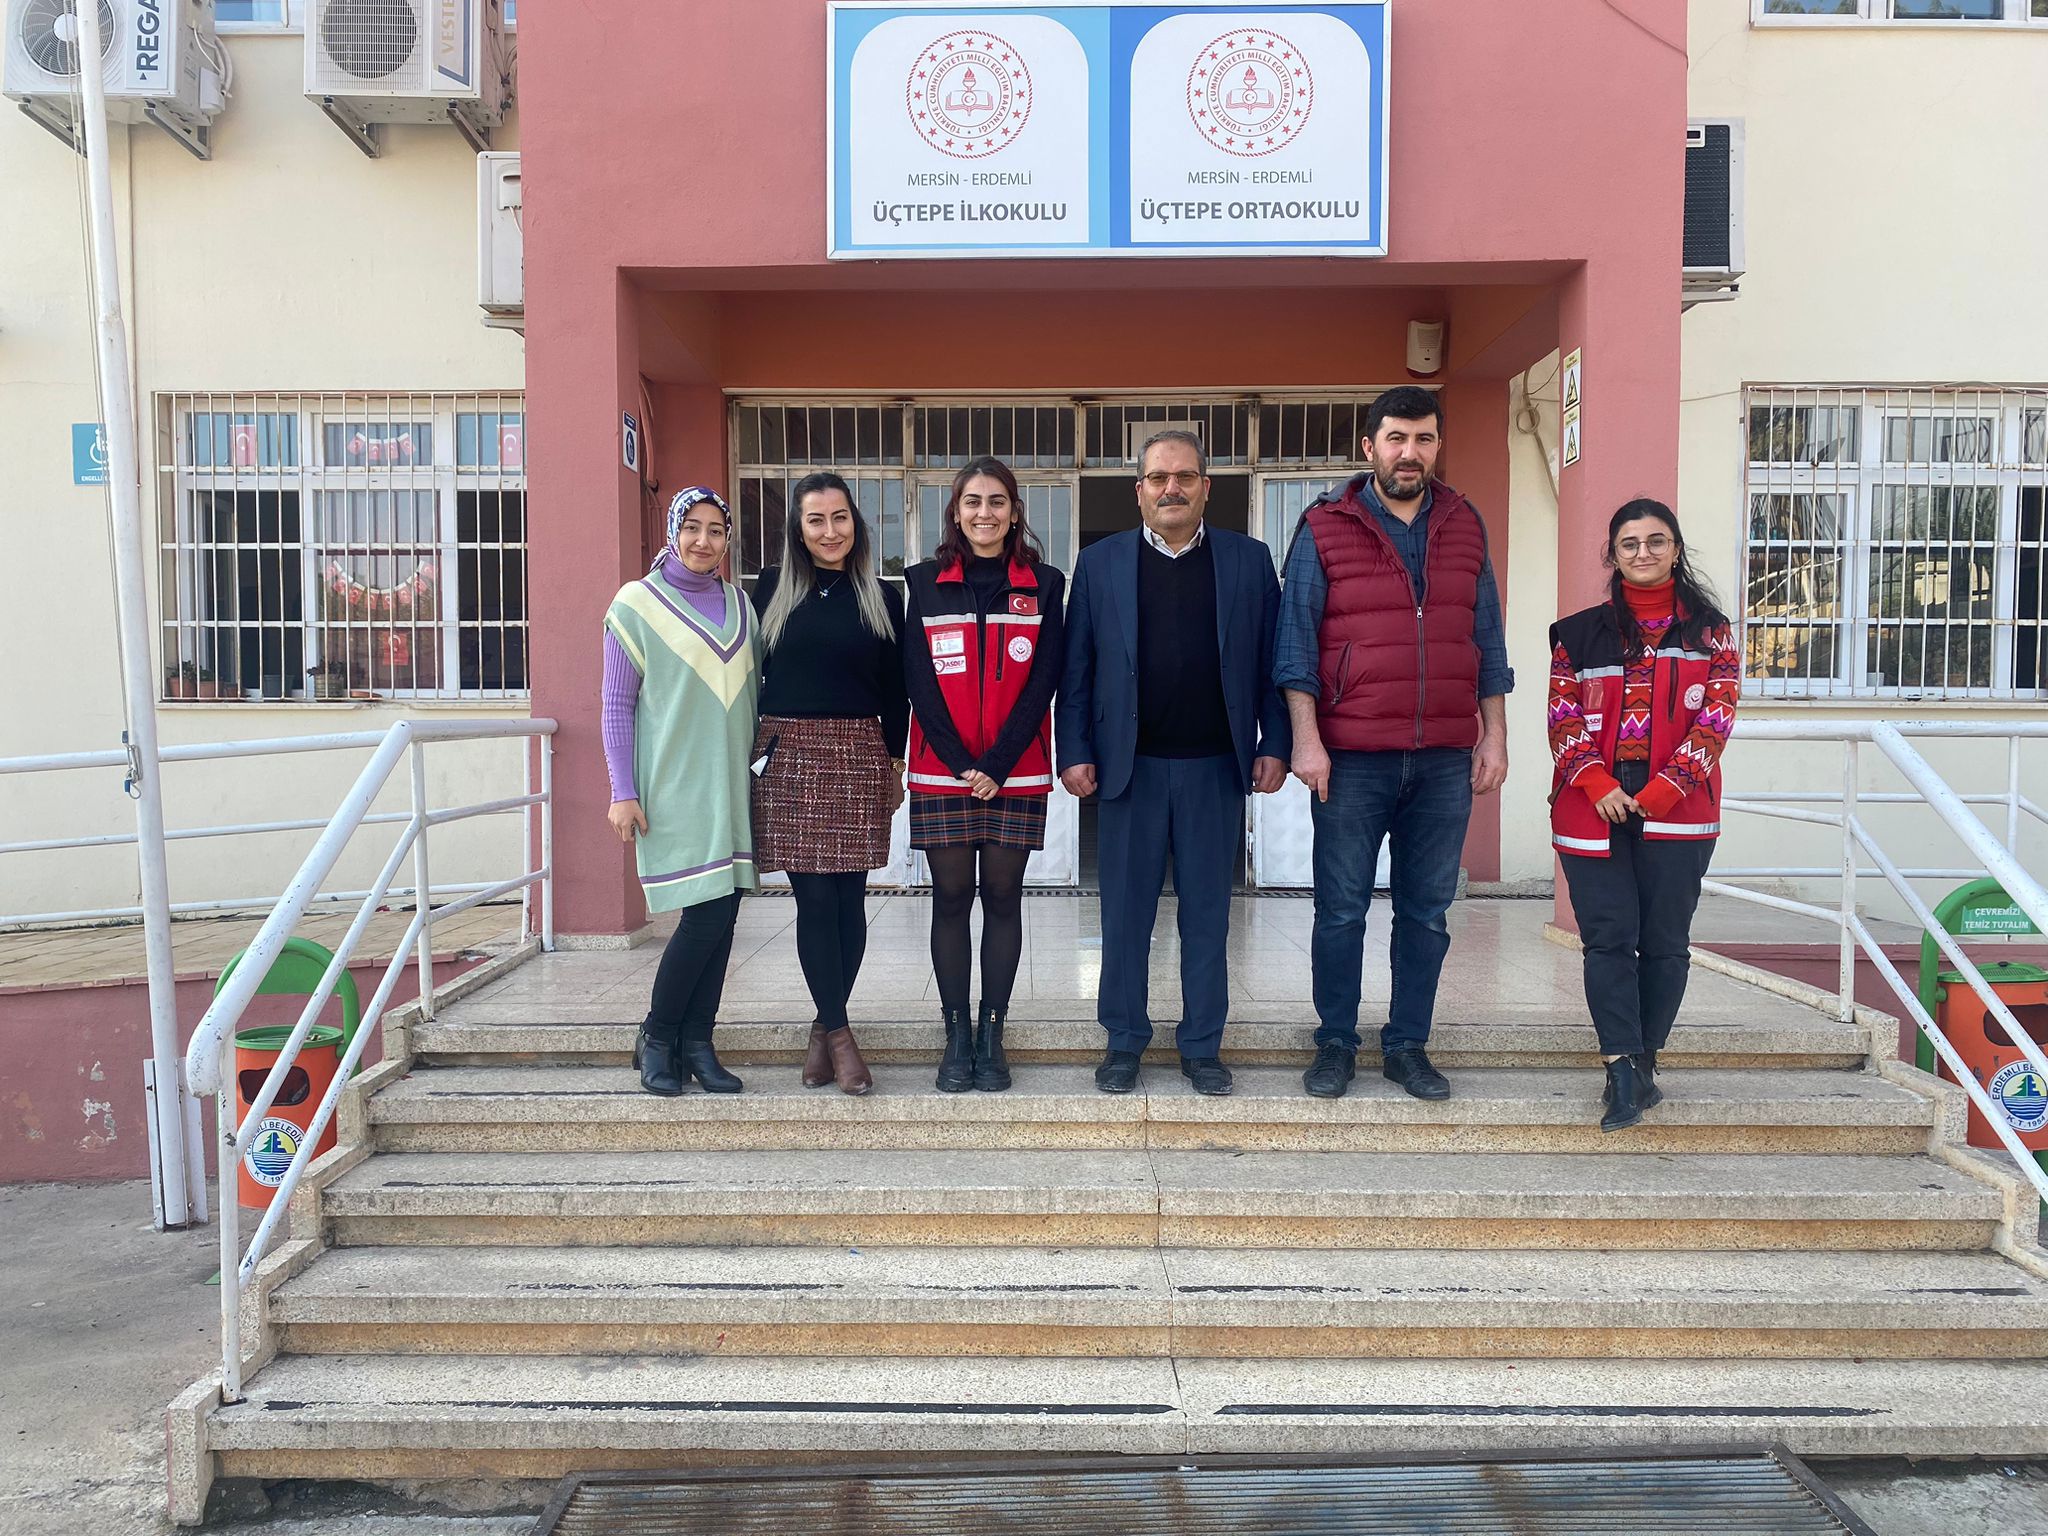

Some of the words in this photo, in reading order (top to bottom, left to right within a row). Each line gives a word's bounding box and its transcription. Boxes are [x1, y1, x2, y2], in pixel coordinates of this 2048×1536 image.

[966, 53, 990, 65] MİLLİ
[1247, 51, 1271, 63] MİLLİ
[929, 54, 964, 104] CUMHURİYETİ
[990, 62, 1009, 92] EĞİTİM
[1210, 52, 1245, 102] CUMHURİYETİ
[1271, 60, 1290, 90] EĞİTİM
[932, 106, 961, 134] TÜRKİYE
[978, 94, 1010, 133] BAKANLIĞI
[1212, 104, 1241, 132] TÜRKİYE
[1259, 92, 1290, 132] BAKANLIĞI
[907, 170, 960, 186] MERSİN
[971, 170, 1032, 186] ERDEMLİ
[1187, 168, 1240, 184] MERSİN
[1252, 168, 1312, 184] ERDEMLİ
[873, 200, 954, 227] ÜÇTEPE
[960, 199, 1067, 221] İLKOKULU
[1140, 198, 1222, 225] ÜÇTEPE
[1228, 200, 1360, 220] ORTAOKULU
[1964, 919, 1990, 929] TEMİZ
[1991, 920, 2029, 929] TUTALIM
[1992, 1063, 2021, 1100] ERDEMLİ
